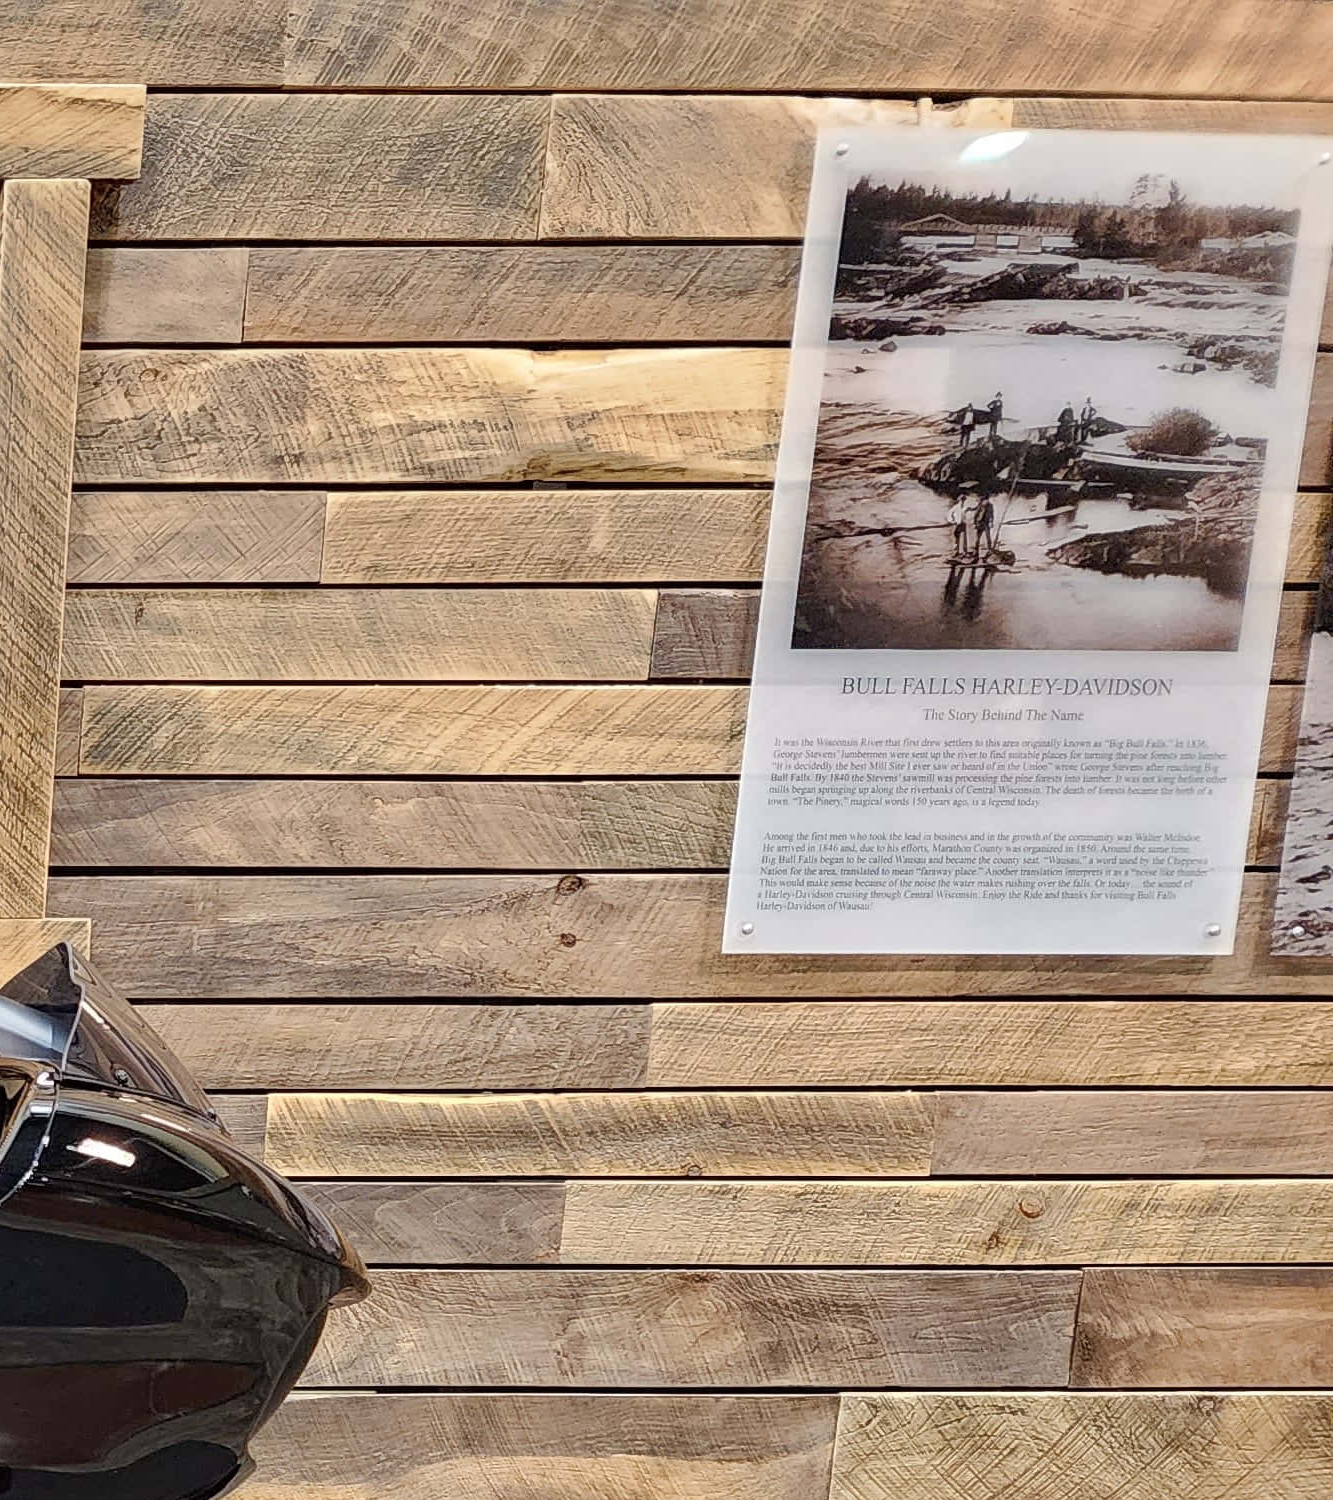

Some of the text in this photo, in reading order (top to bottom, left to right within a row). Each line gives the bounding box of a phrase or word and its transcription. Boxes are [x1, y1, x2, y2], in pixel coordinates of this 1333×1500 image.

[842, 676, 1173, 696] BULL FALLS HARLEY-DAVIDSON
[923, 708, 1084, 723] The Story Behind The Name
[801, 738, 814, 746] the
[943, 750, 956, 759] the
[980, 750, 988, 759] to
[835, 762, 849, 770] the
[852, 773, 865, 782] the
[1001, 774, 1014, 782] the
[896, 786, 909, 794] the
[955, 786, 966, 794] of
[797, 832, 809, 841] the
[889, 832, 902, 841] the
[970, 833, 985, 841] and
[979, 856, 991, 865] the
[804, 867, 817, 875] the
[900, 879, 912, 888] the
[939, 879, 950, 888] the
[1009, 891, 1022, 899] the
